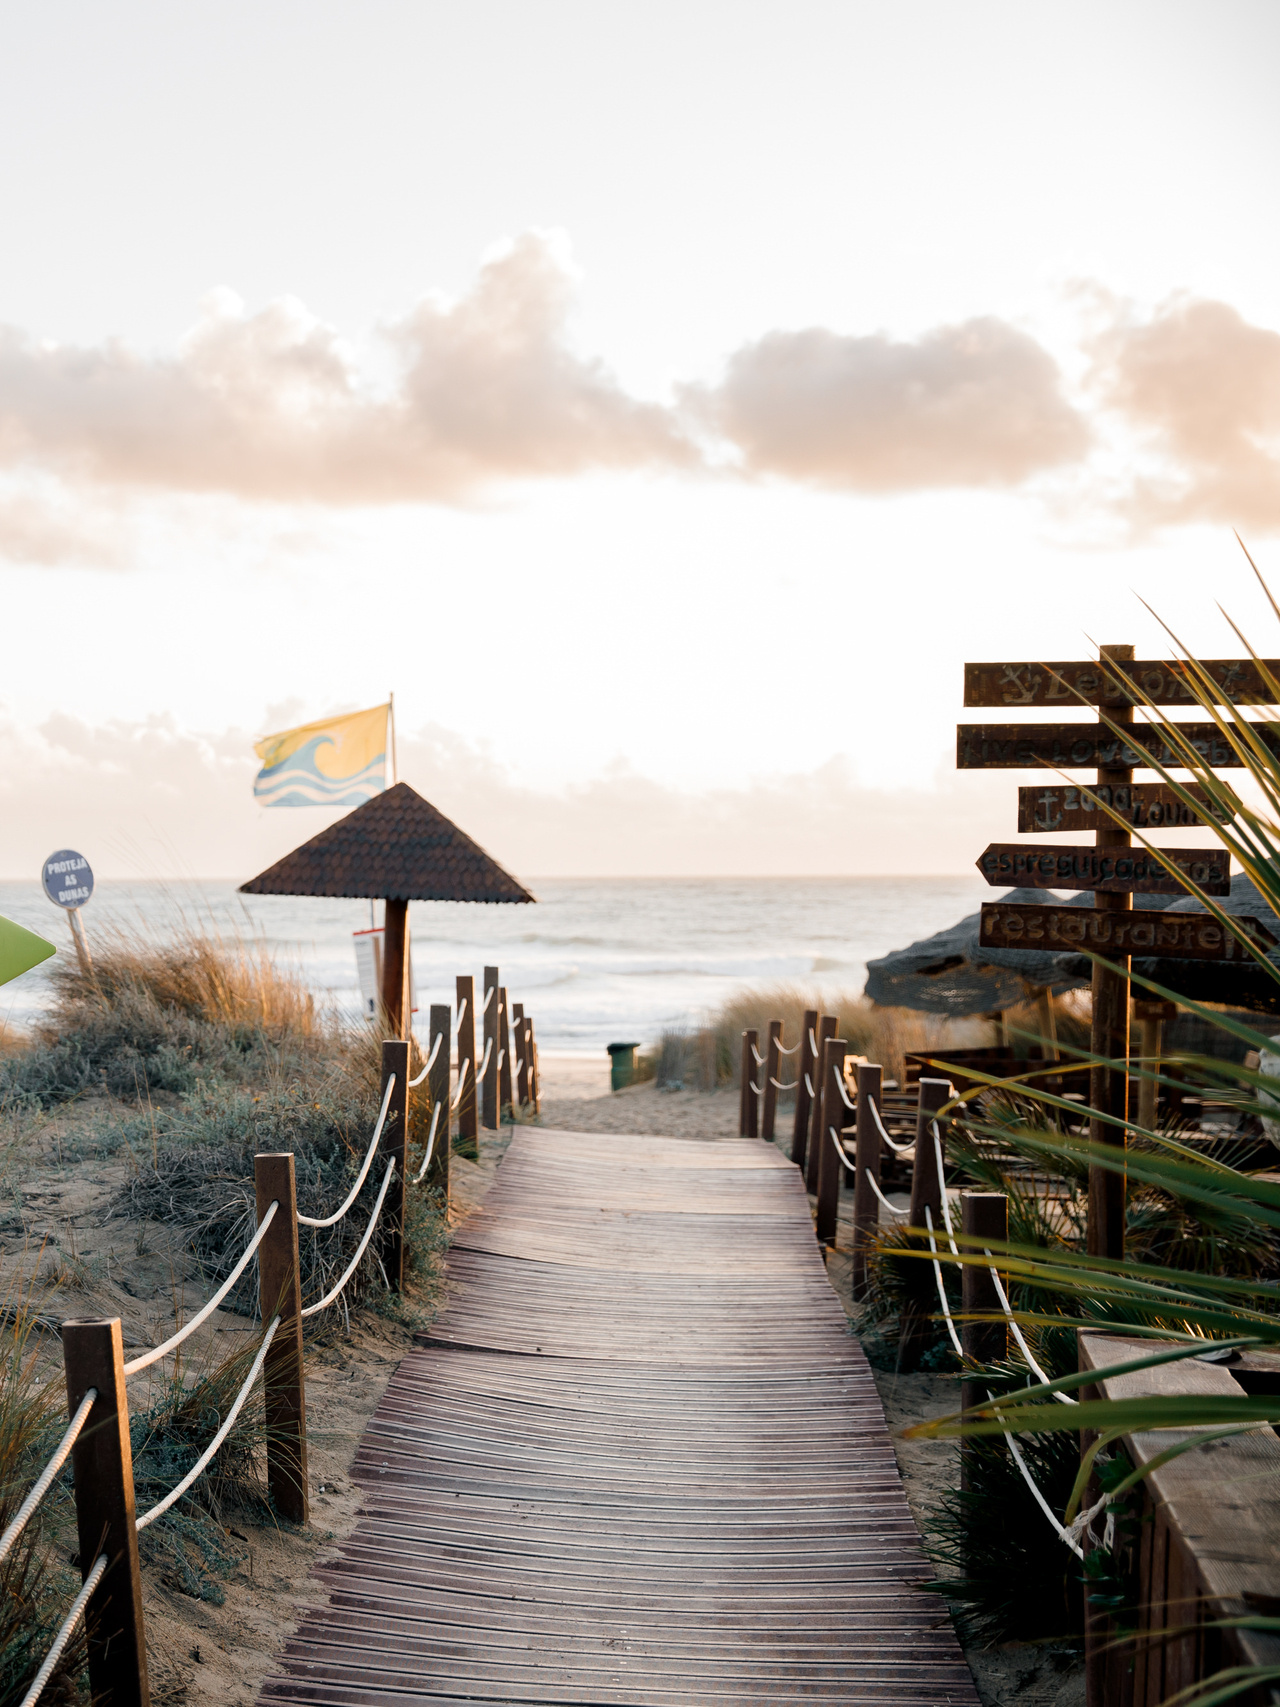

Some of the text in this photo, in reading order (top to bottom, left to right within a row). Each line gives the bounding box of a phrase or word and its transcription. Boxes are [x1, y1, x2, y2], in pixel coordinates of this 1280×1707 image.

[47, 858, 88, 875] PROTEJA
[982, 850, 1224, 886] espreguiçaderas
[65, 874, 77, 886] AS
[58, 886, 89, 902] DUNAS
